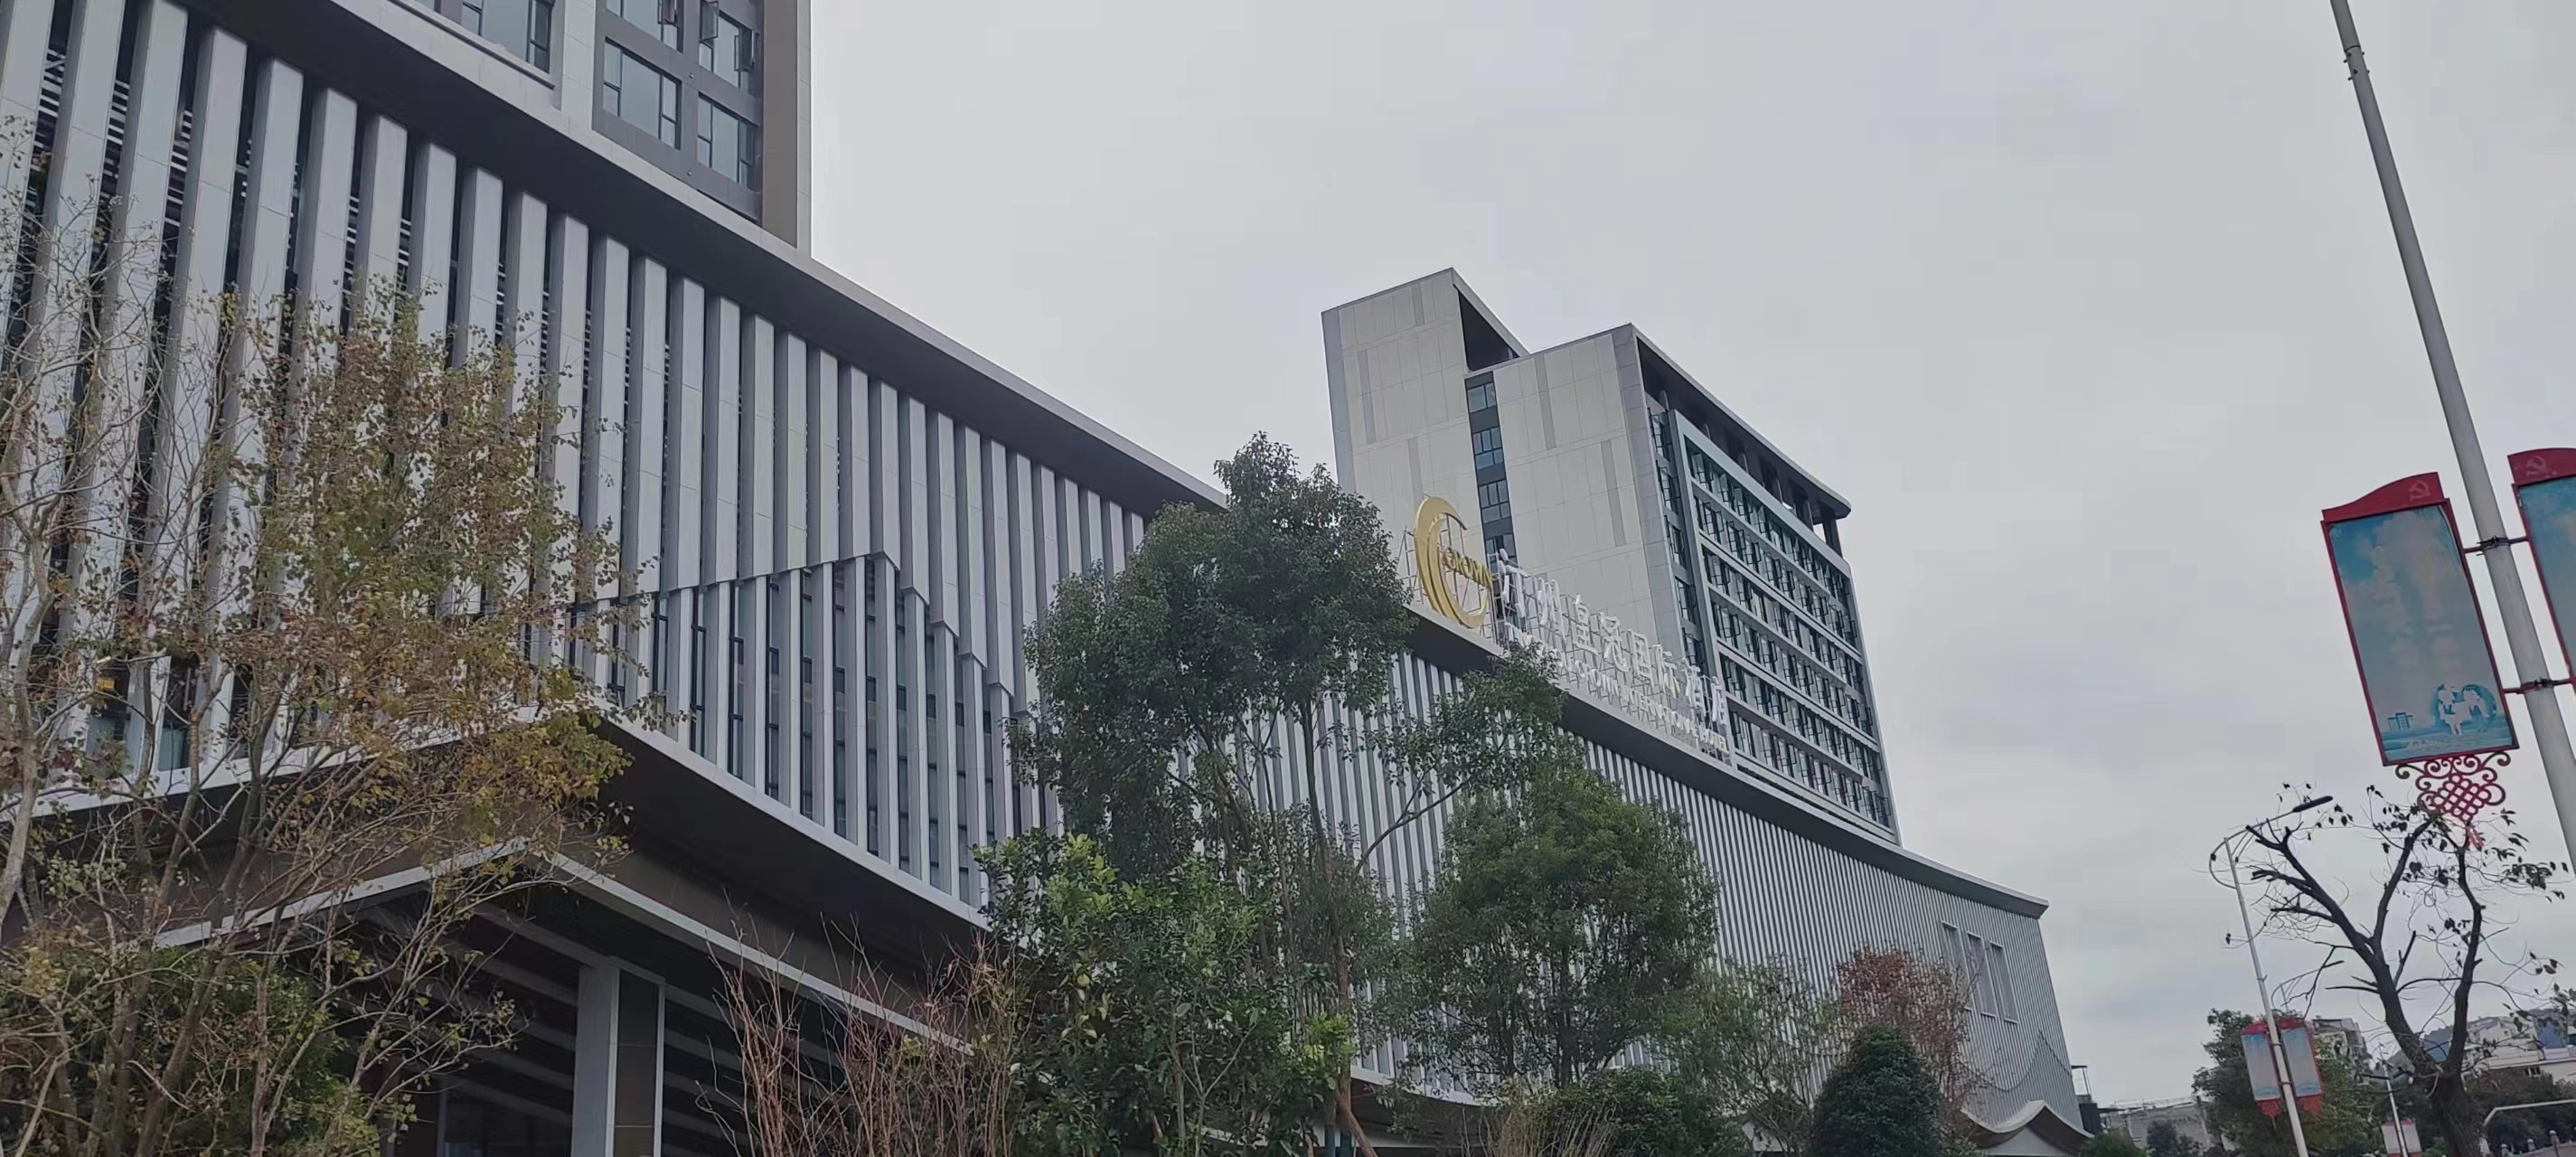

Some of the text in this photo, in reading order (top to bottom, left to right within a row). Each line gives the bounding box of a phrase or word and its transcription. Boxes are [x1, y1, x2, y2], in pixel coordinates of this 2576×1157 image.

[1443, 546, 1493, 588] CROWN
[1499, 548, 1727, 725] 汀州皇冠国际酒店
